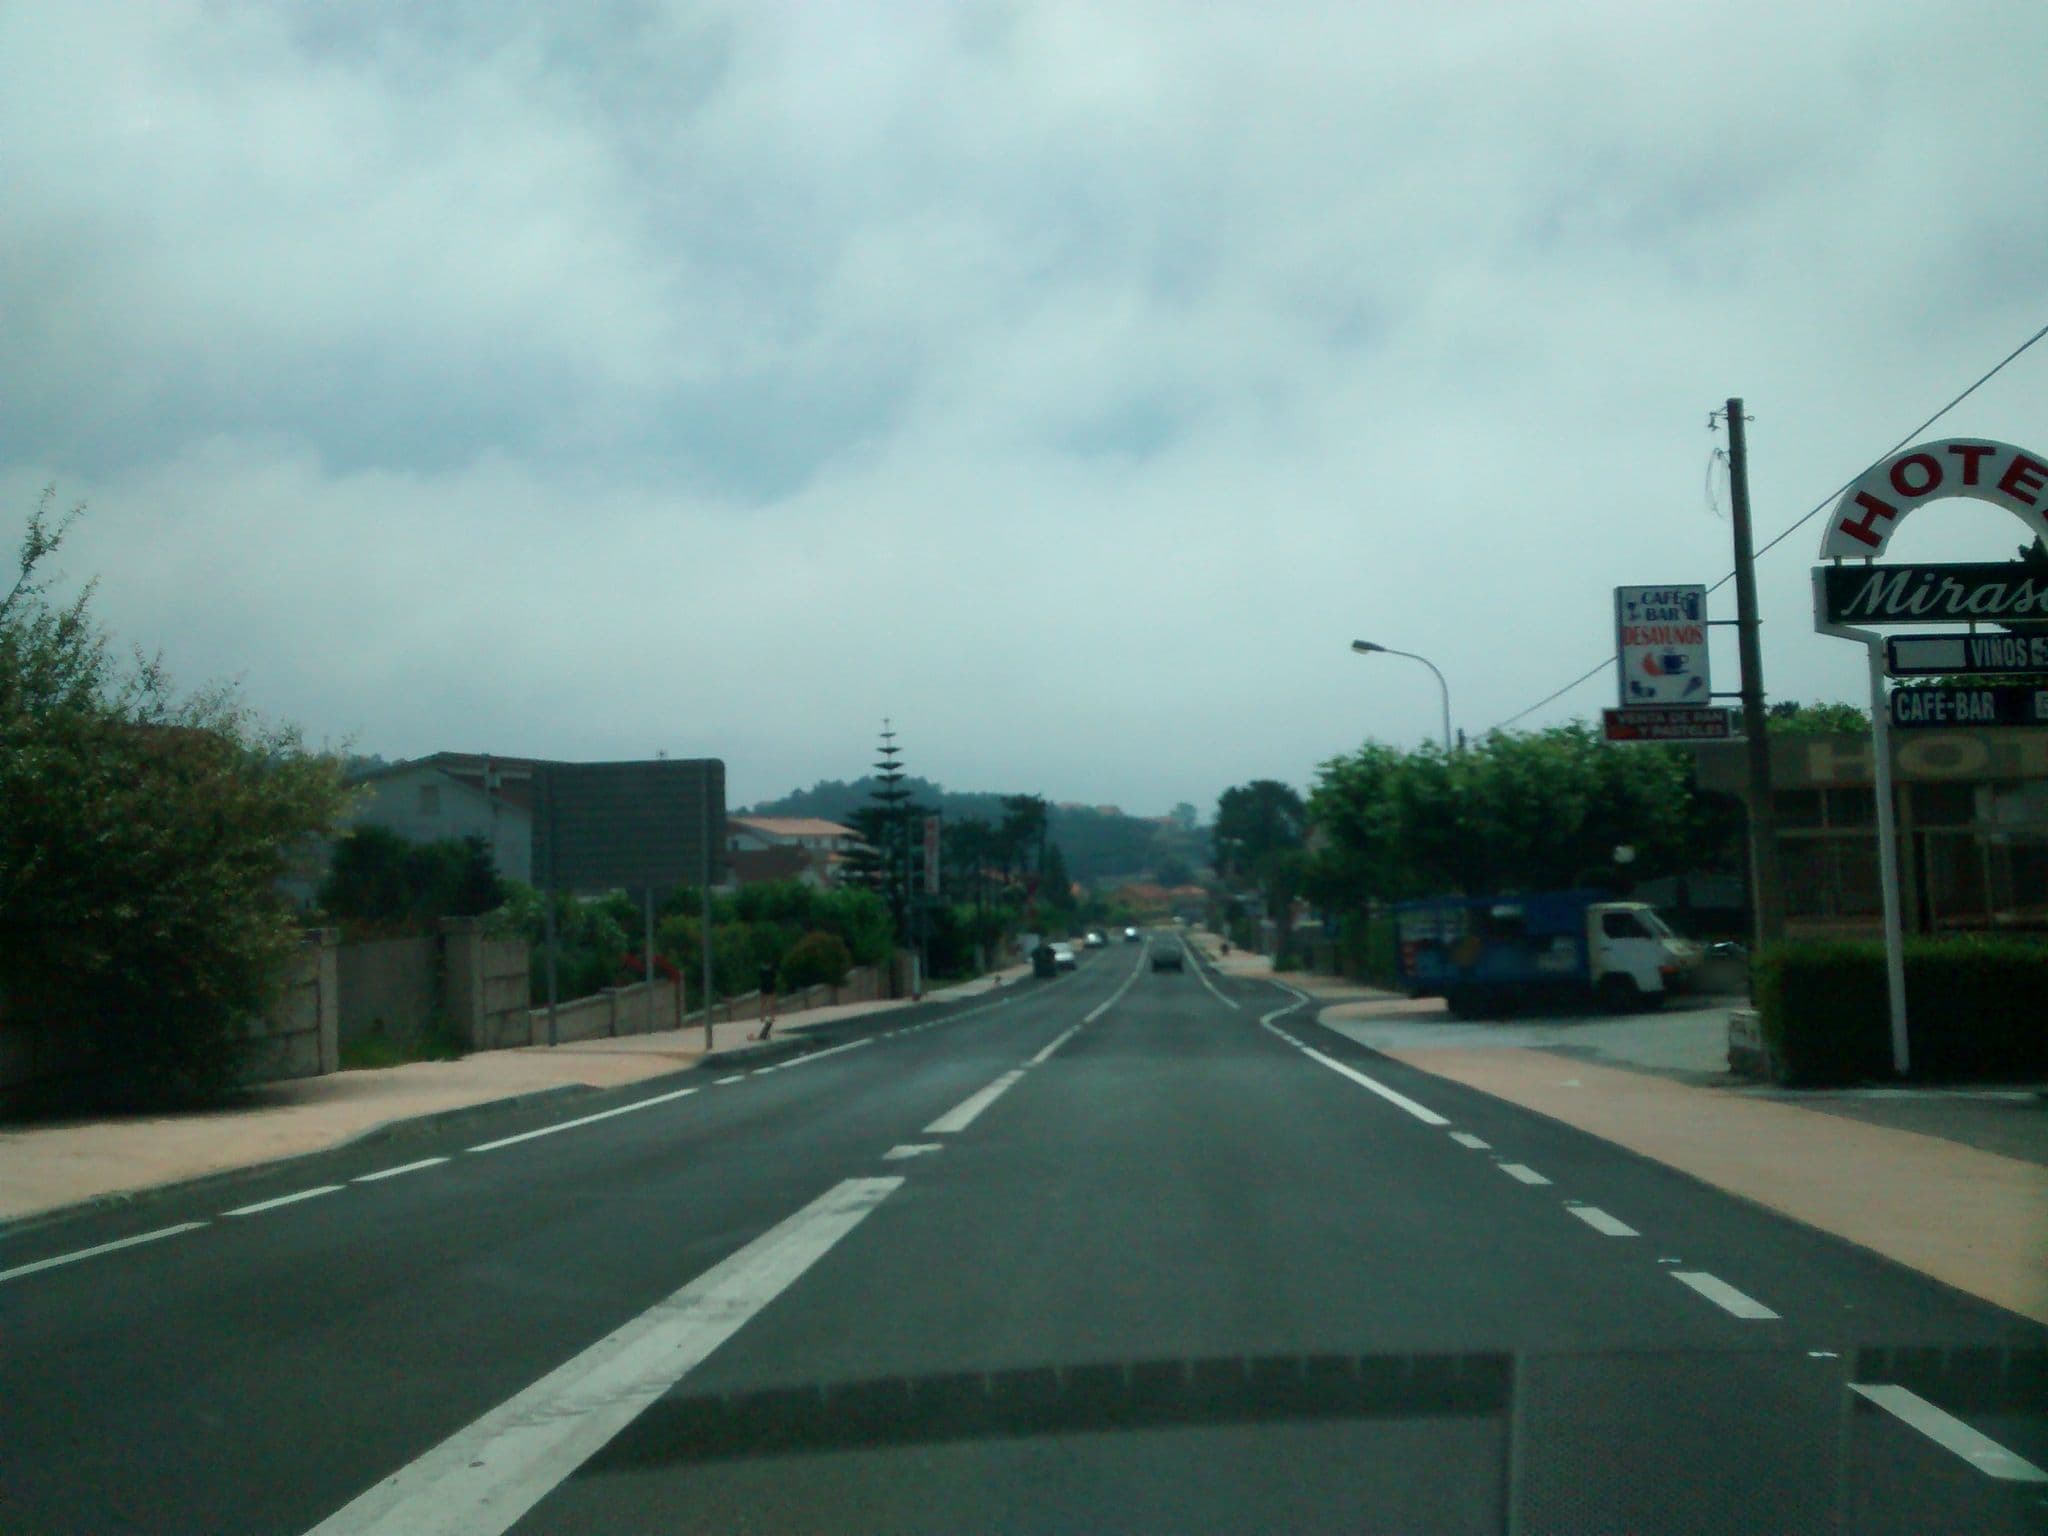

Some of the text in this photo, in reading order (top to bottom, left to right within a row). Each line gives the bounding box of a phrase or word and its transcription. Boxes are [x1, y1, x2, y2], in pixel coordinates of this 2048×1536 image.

[1839, 444, 2048, 548] HOTE
[1646, 607, 1680, 621] BAR
[1621, 625, 1704, 646] DESAYUNOS
[1693, 711, 1723, 723] PAN
